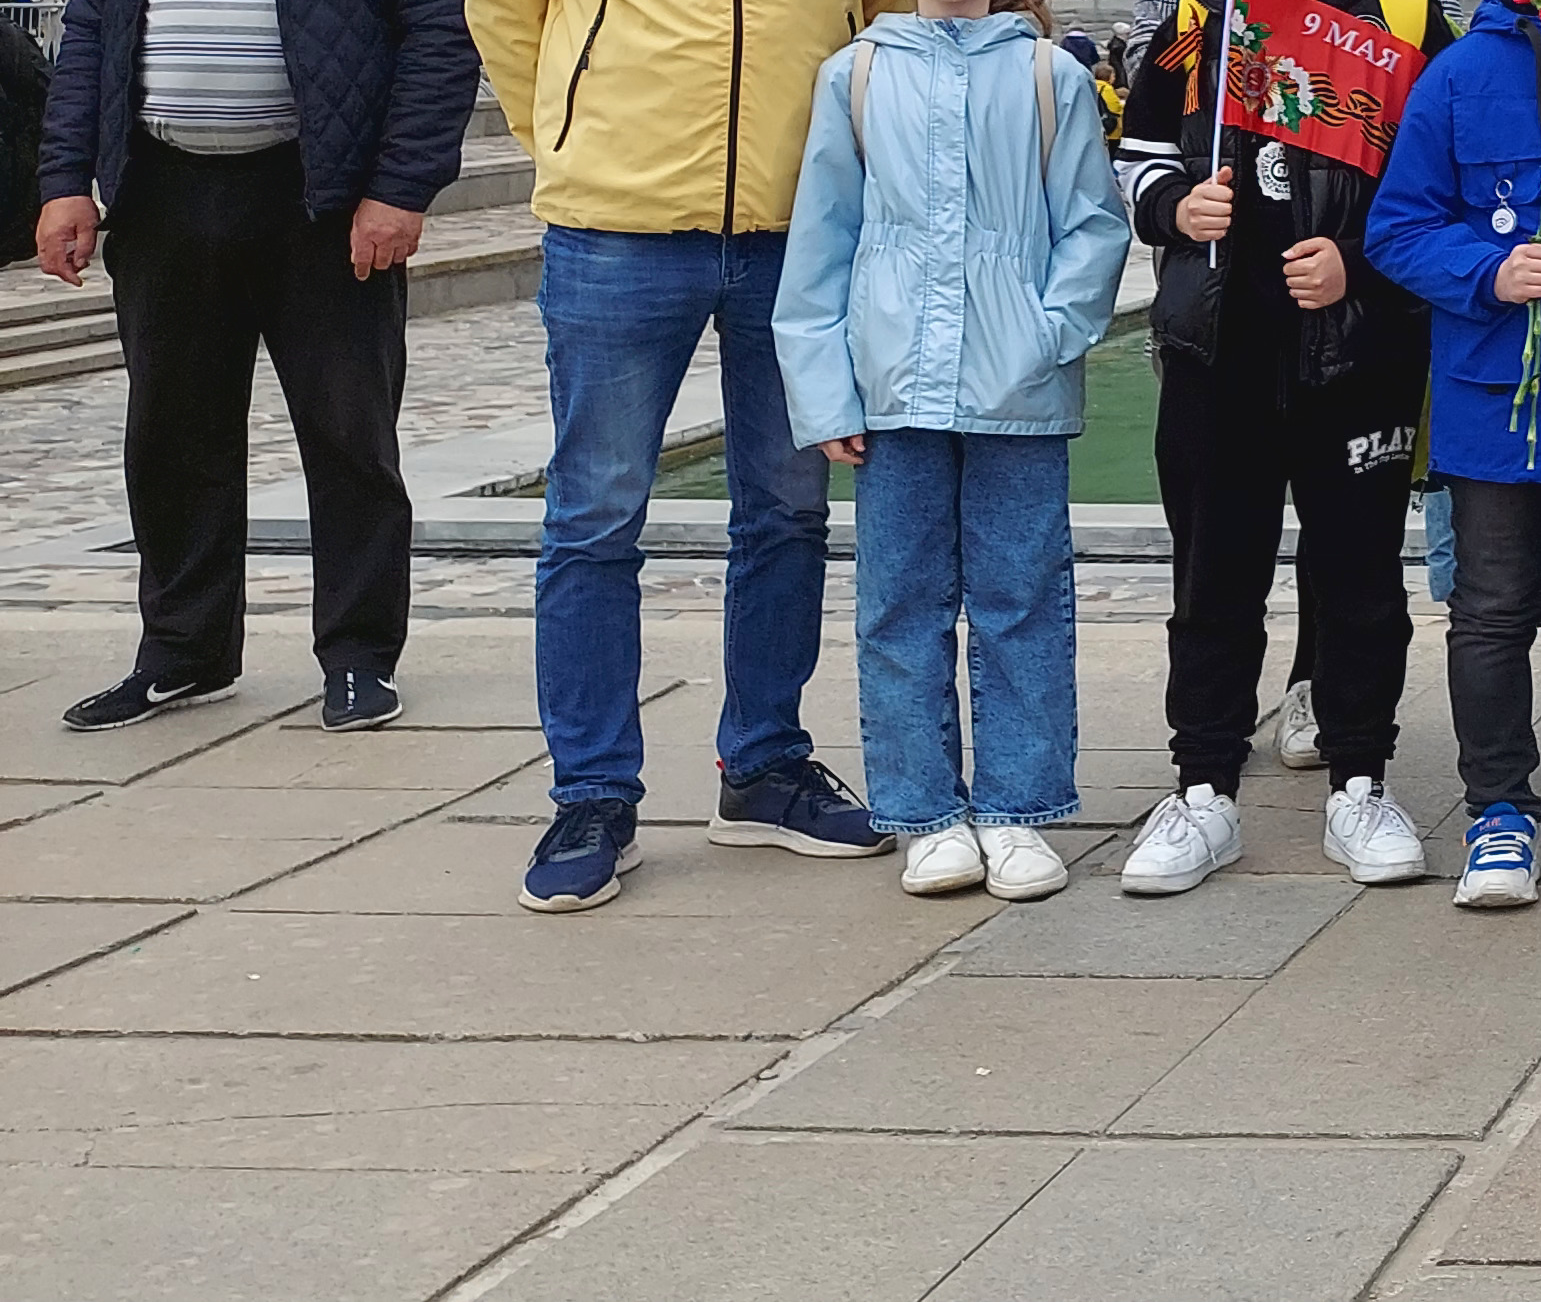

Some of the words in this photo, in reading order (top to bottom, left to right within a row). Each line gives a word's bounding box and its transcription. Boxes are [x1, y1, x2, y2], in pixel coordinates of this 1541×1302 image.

[1301, 13, 1321, 35] 9
[1322, 20, 1402, 74] МАЯ
[1347, 426, 1416, 466] PLAY
